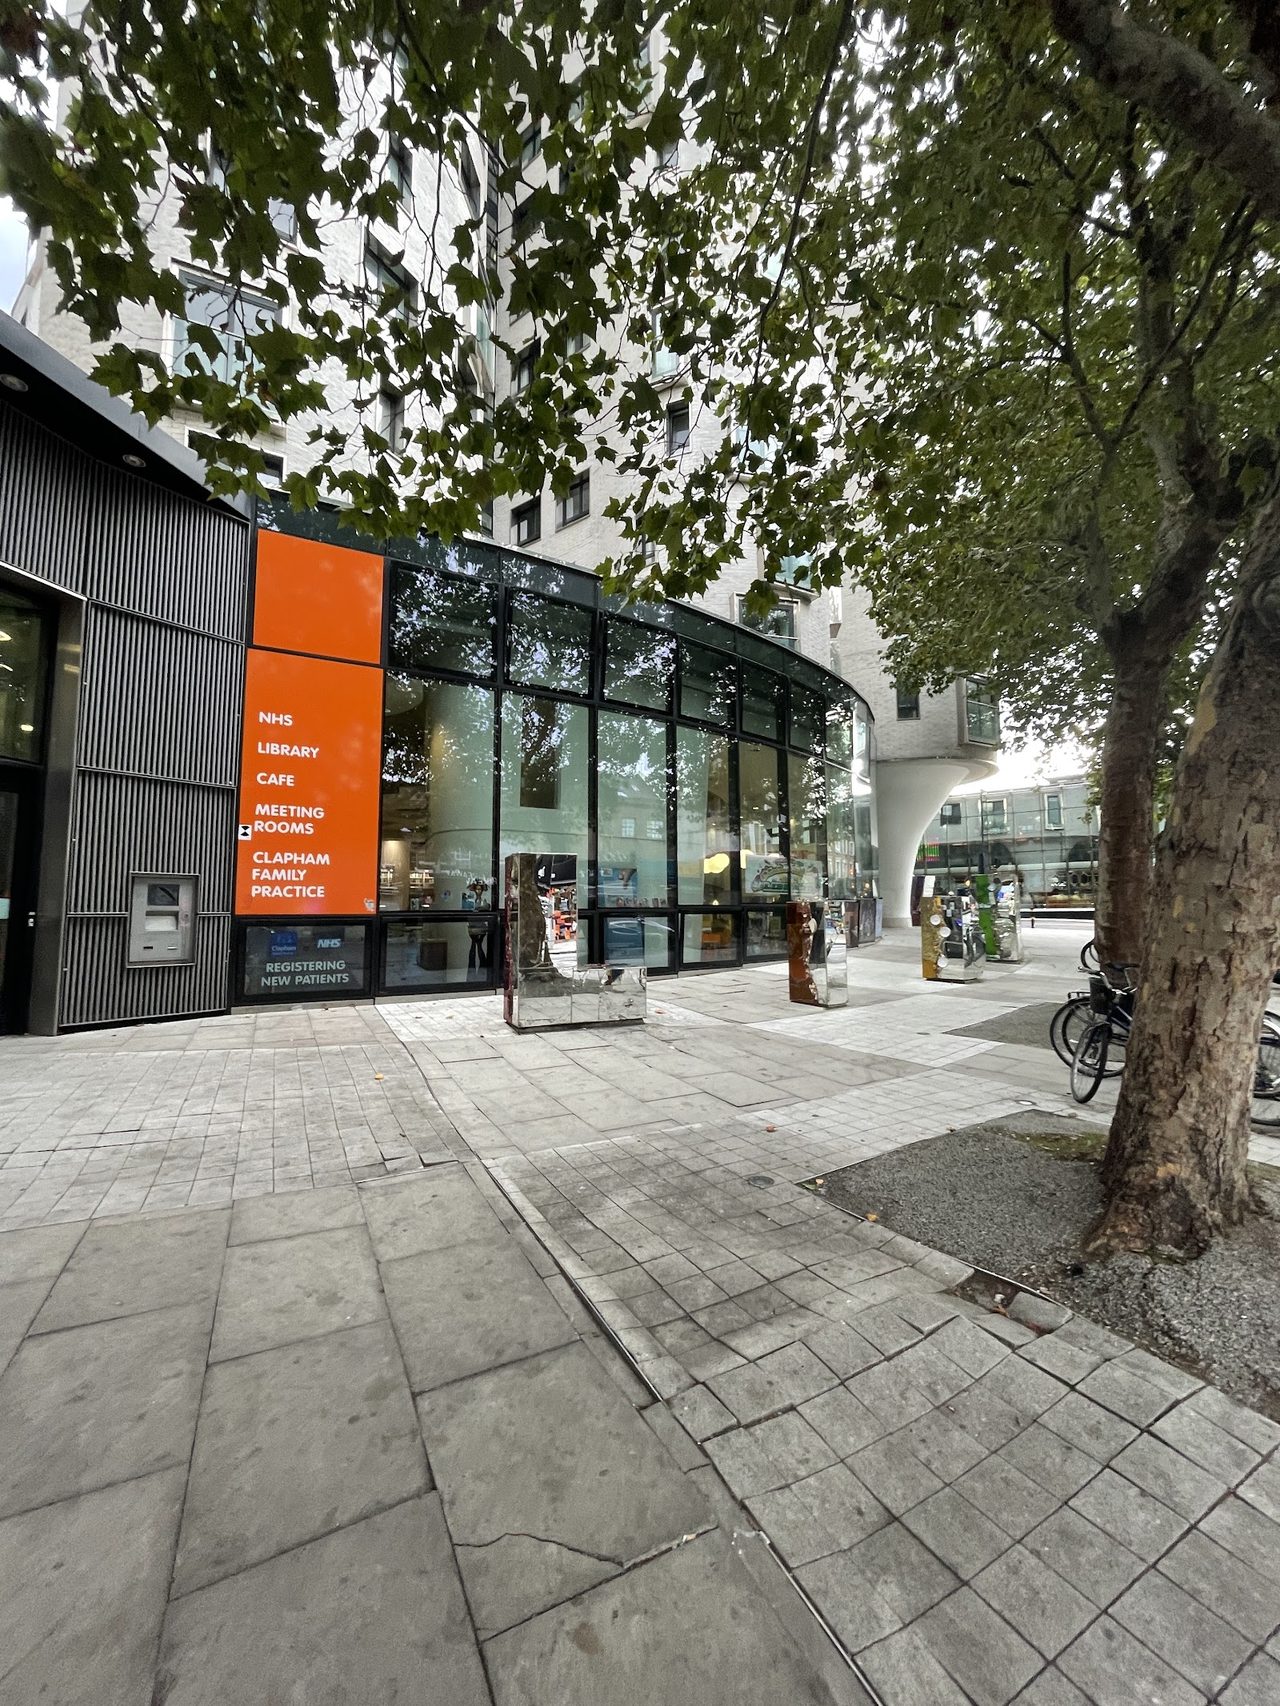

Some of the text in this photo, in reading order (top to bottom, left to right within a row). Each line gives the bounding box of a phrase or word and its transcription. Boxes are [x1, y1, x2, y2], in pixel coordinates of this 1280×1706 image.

[259, 711, 293, 726] NHS
[257, 742, 319, 758] LIBRARY
[256, 772, 295, 786] CAFE
[255, 803, 325, 819] MEETING
[254, 820, 314, 835] ROOMS
[253, 851, 330, 865] CLAPHAM
[252, 868, 307, 881] FAMILY
[251, 885, 325, 898] PRACTICE
[317, 938, 342, 948] NHS
[266, 960, 346, 973] REGISTERING
[261, 973, 349, 987] NEW PATIENTS
